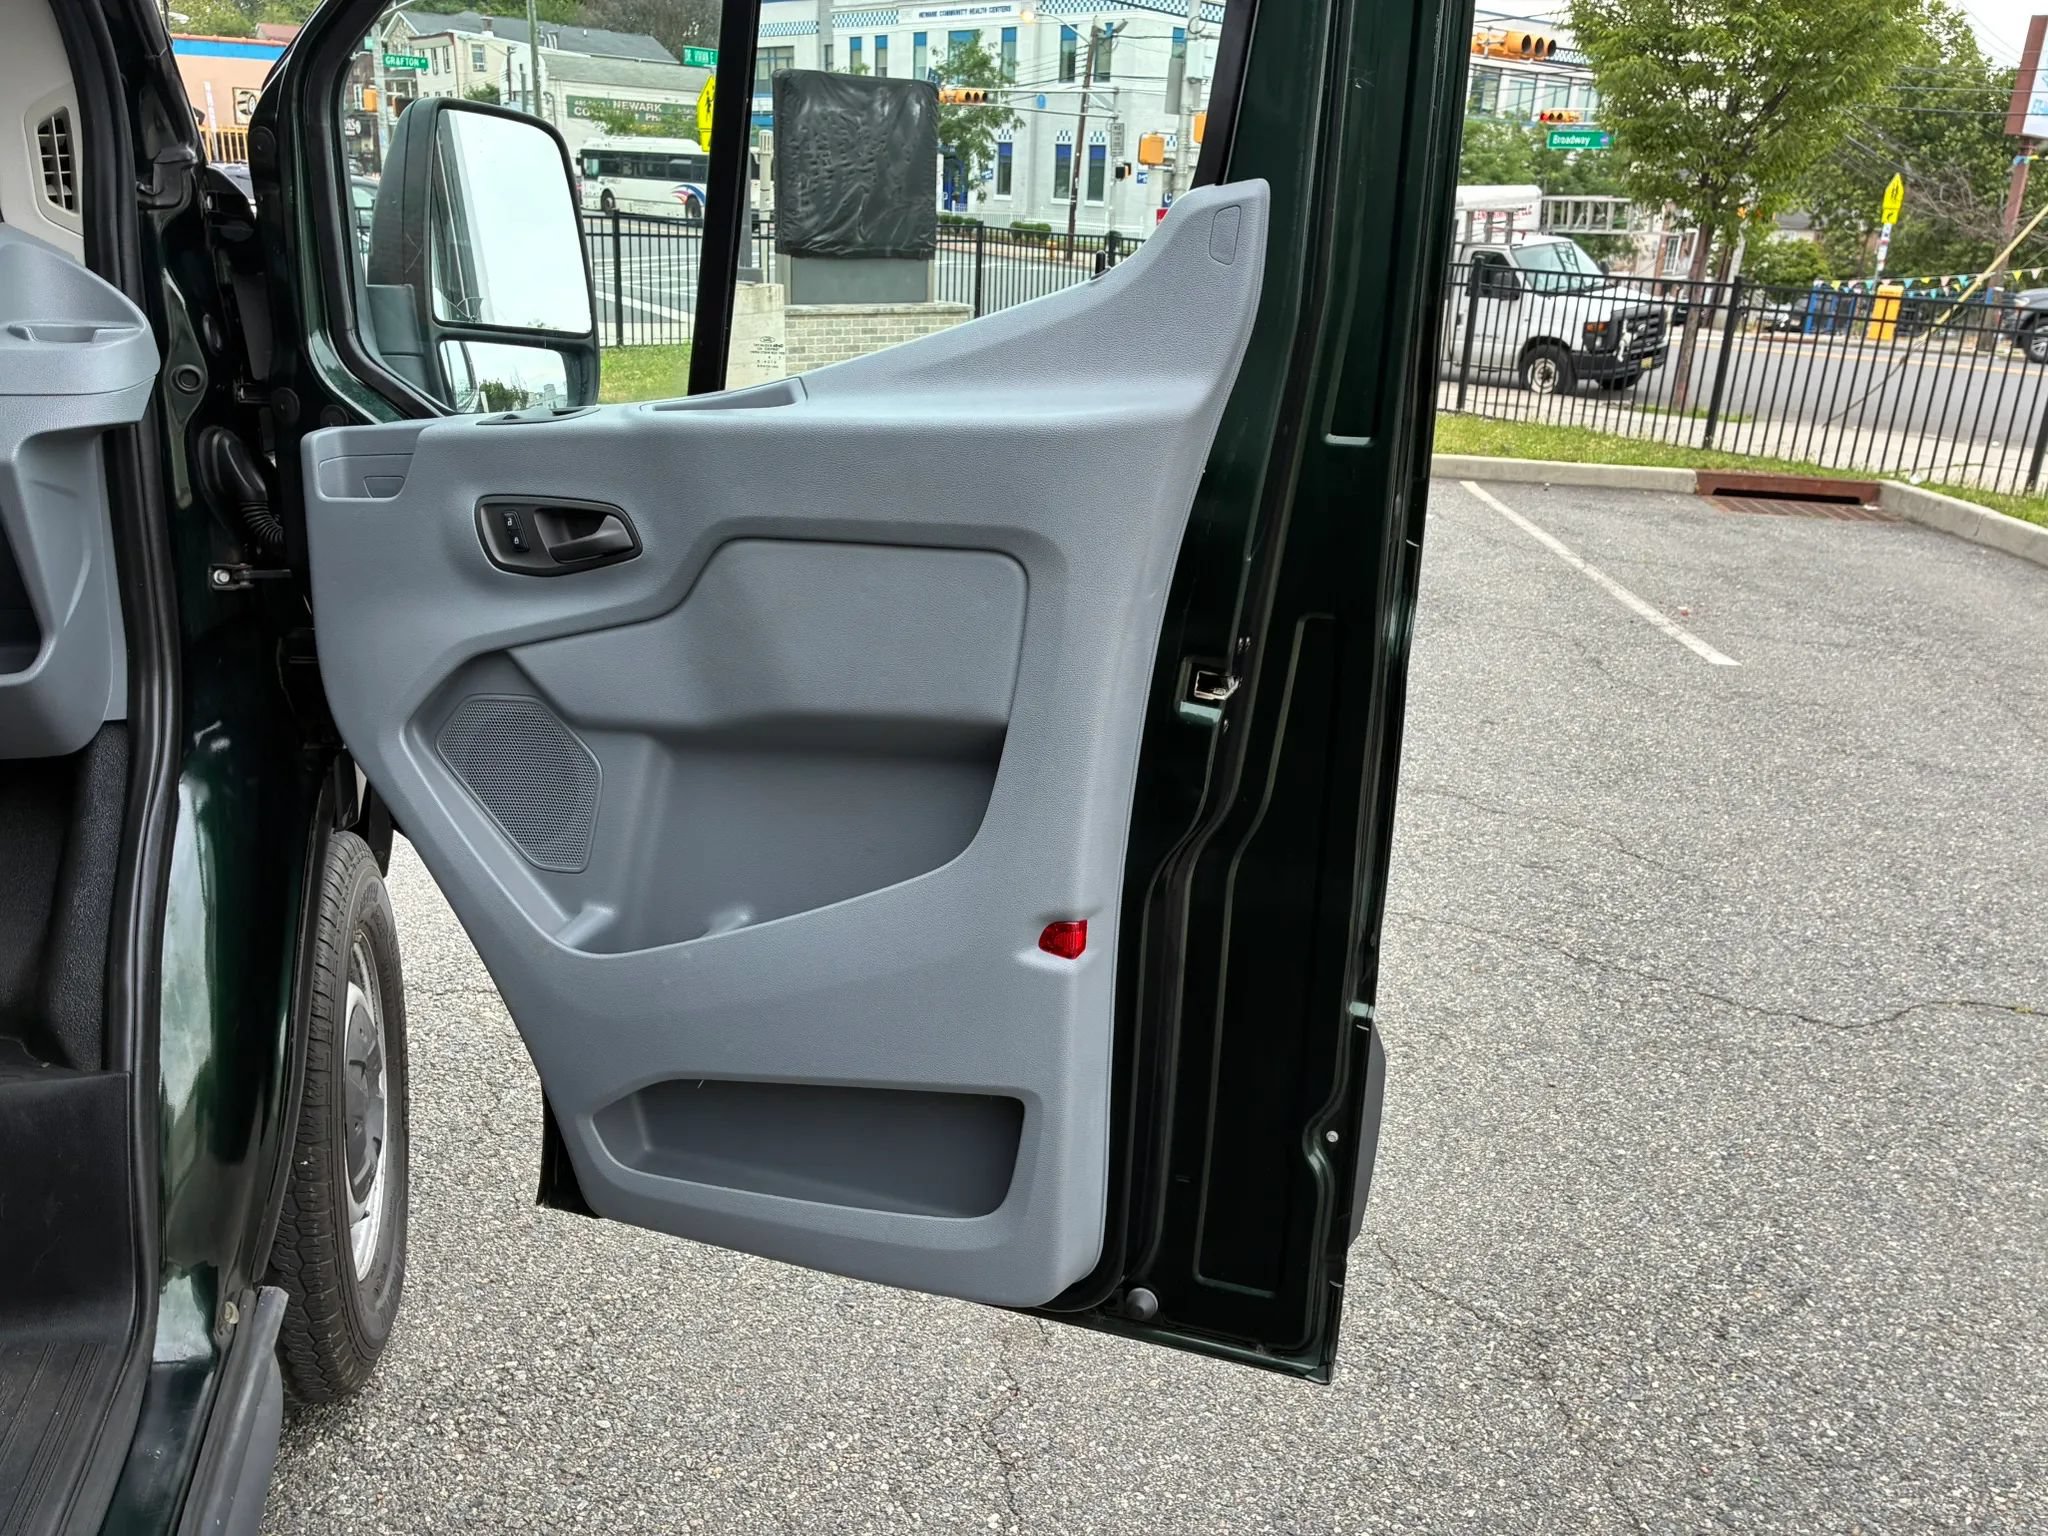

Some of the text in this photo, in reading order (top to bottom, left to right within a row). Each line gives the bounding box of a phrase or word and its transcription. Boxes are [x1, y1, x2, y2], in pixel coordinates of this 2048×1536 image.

[969, 7, 987, 15] HEALTH
[385, 55, 420, 67] GRAFTON
[612, 100, 662, 113] NEWARK
[1552, 134, 1591, 147] Broadway
